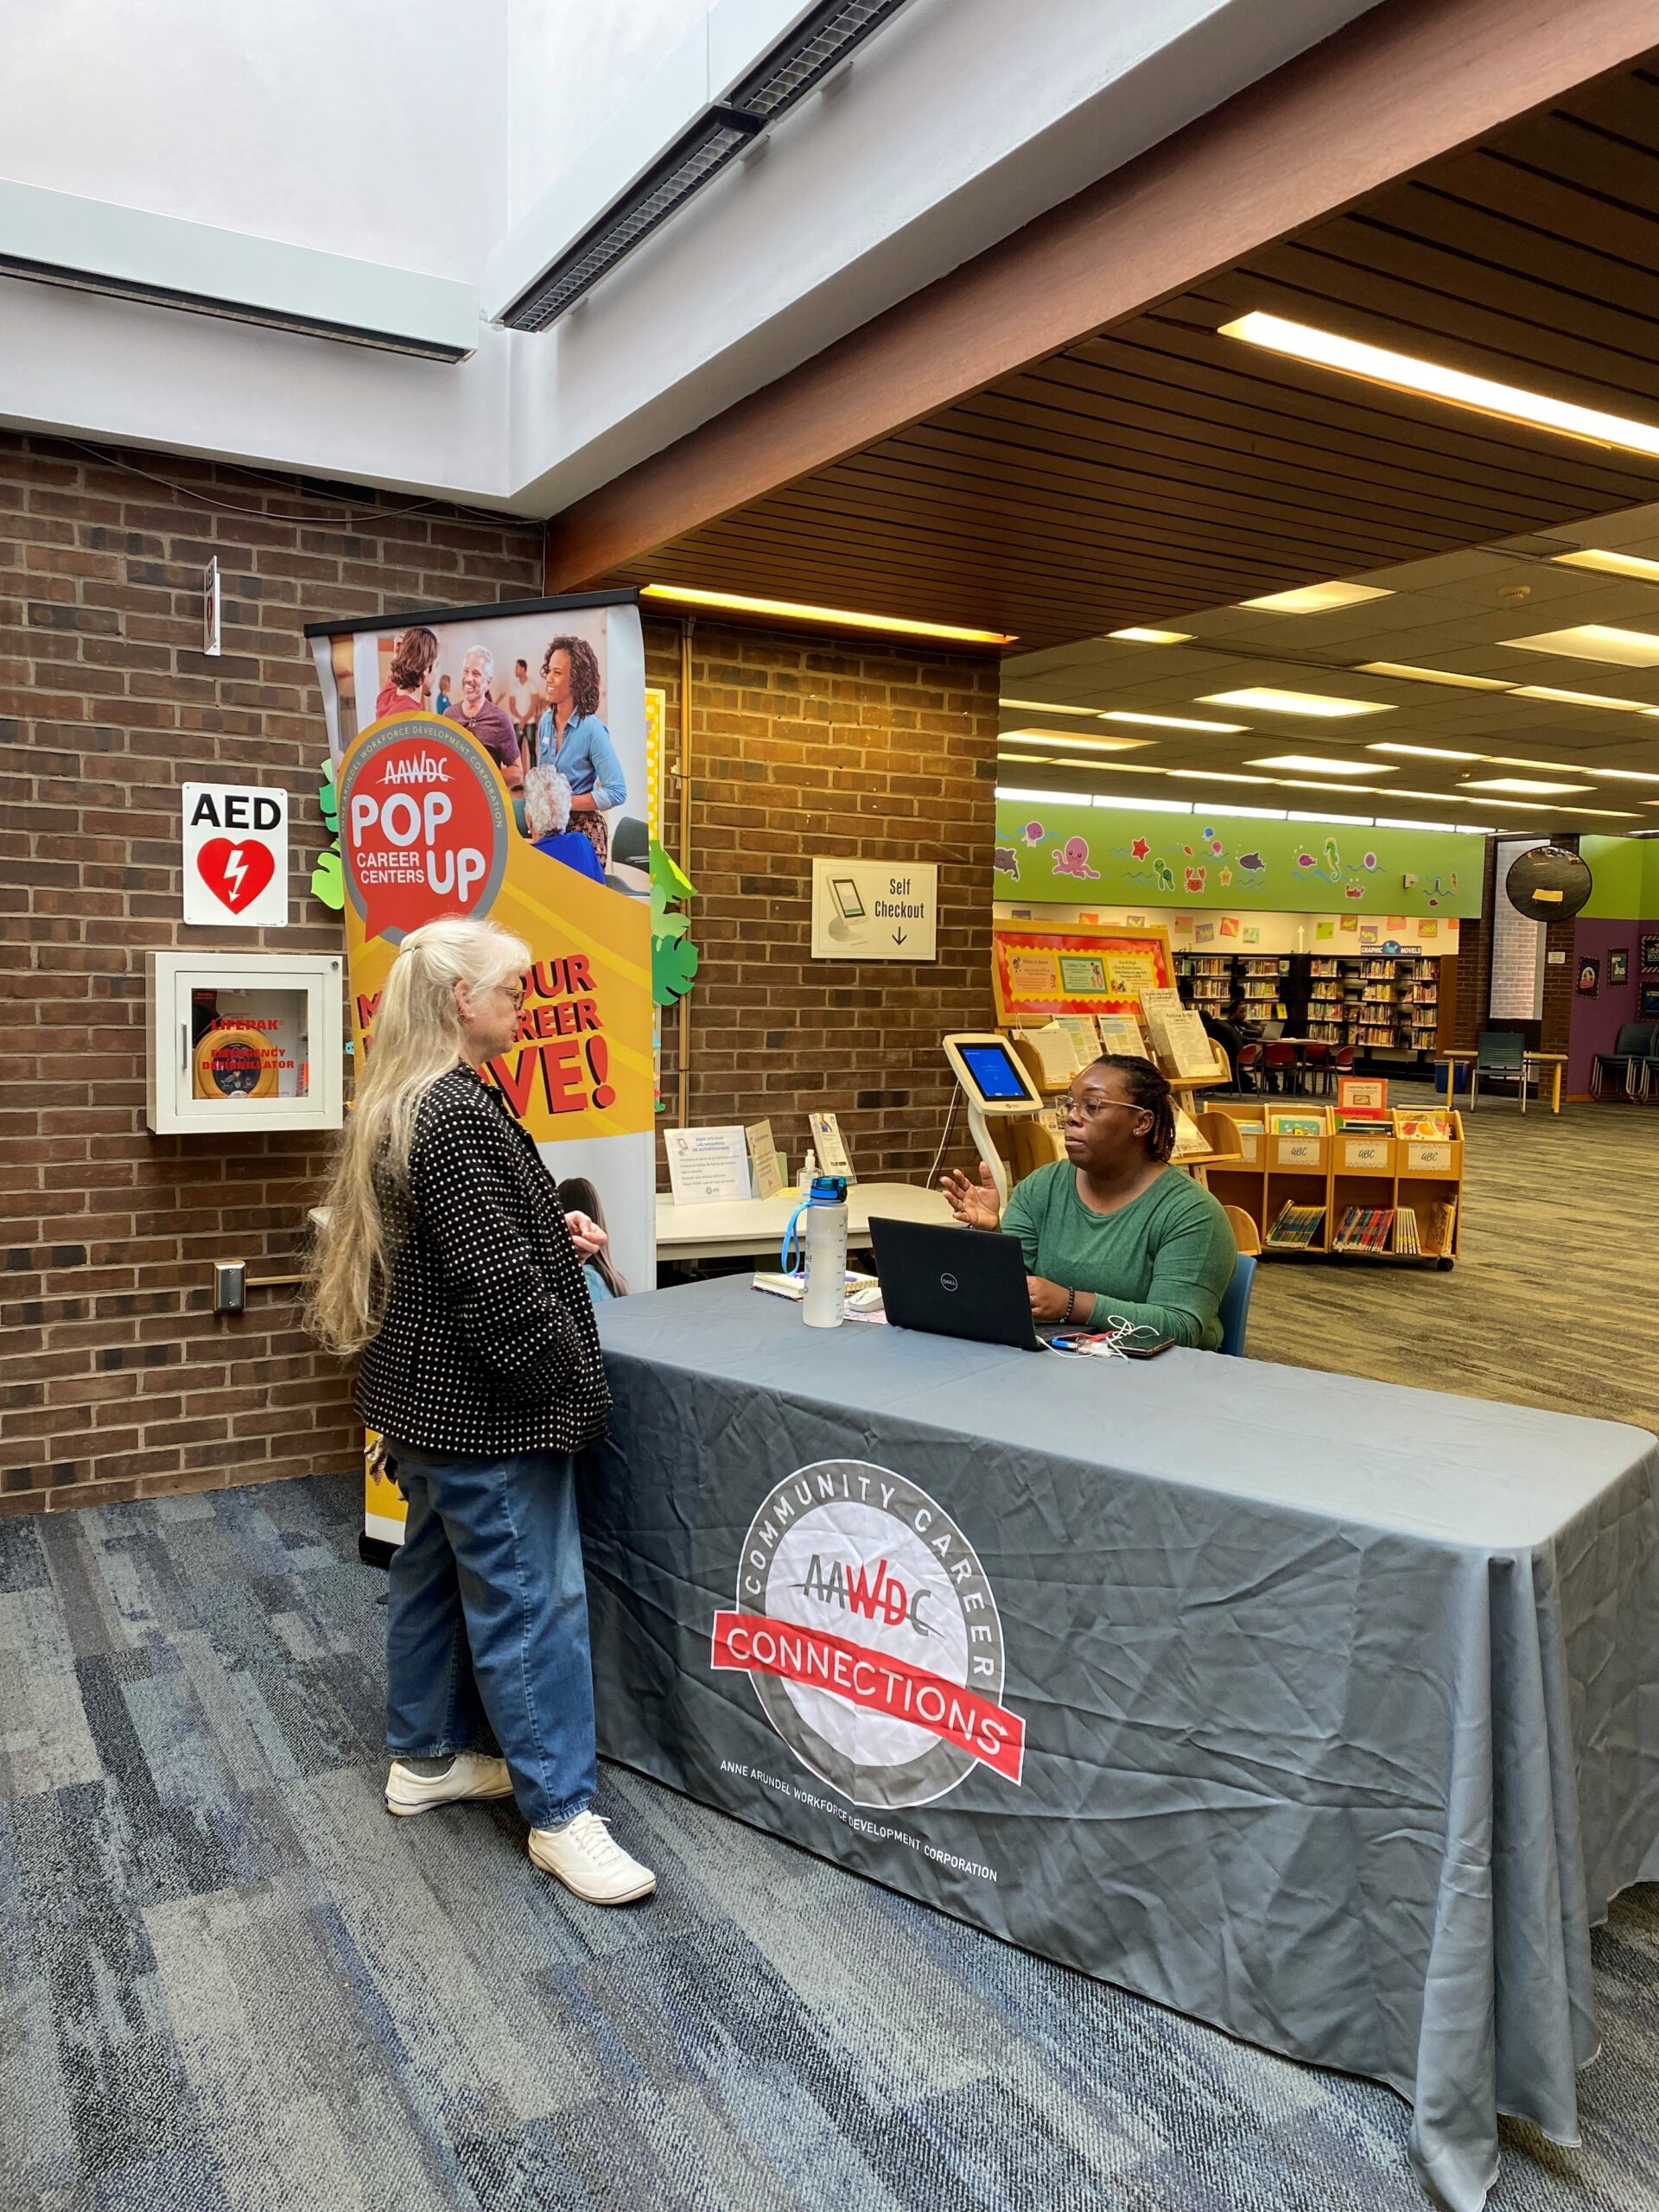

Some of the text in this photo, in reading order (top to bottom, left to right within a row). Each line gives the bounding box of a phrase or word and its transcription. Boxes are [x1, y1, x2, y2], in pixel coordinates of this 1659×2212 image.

[343, 760, 361, 803] ARUNDEL
[360, 728, 409, 759] WORKFORCE
[412, 726, 470, 755] DEVELOPMENT
[470, 756, 503, 829] CORPORATION
[383, 750, 449, 785] AAWDC
[191, 793, 281, 830] AED
[351, 791, 453, 848] POP
[356, 851, 420, 868] CAREER
[360, 869, 425, 884] CENTERS
[426, 848, 486, 903] UP
[874, 900, 925, 918] Checkout
[889, 878, 911, 895] Self
[519, 954, 598, 1000] OUR
[513, 998, 603, 1042] REER
[477, 1035, 615, 1119] VE!
[745, 1473, 995, 1677] COMMUNITY CAREER
[803, 1554, 931, 1637] AAWDC
[727, 1627, 1009, 1756] CONNECTIONS
[720, 1759, 998, 1883] ANNE ARUNDEL WORKFORCE DEVELOPMENT CORPORATION
